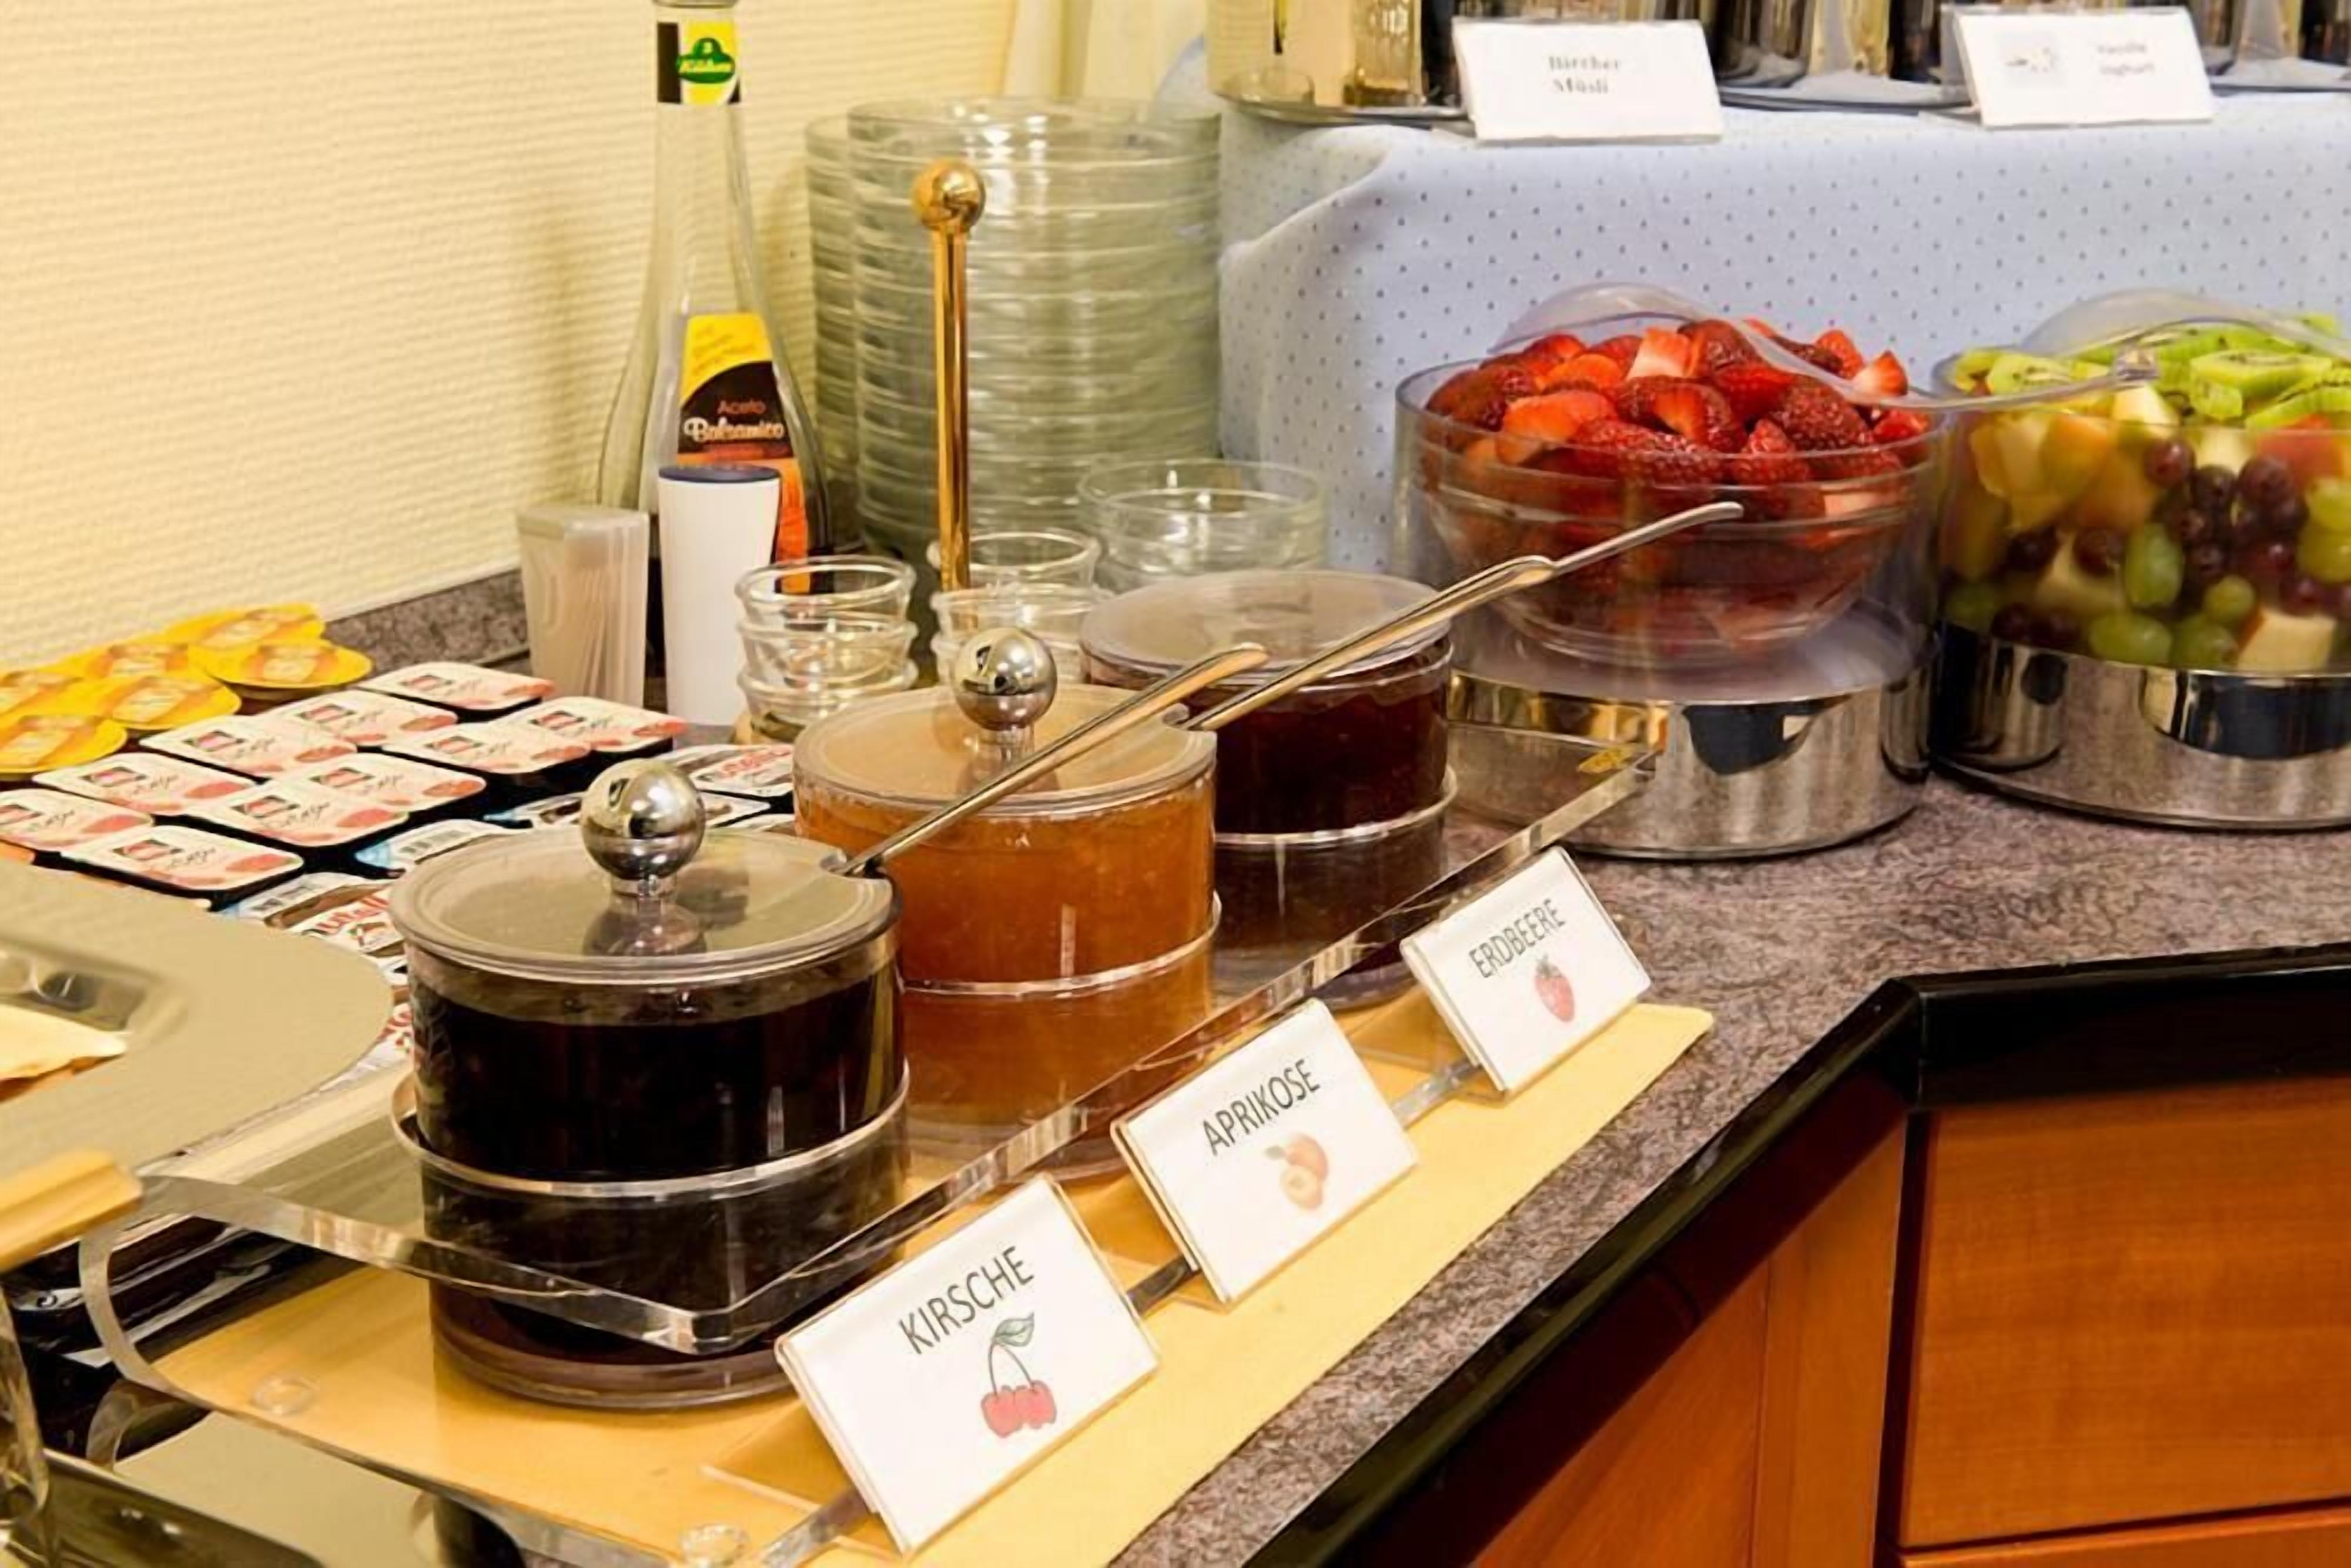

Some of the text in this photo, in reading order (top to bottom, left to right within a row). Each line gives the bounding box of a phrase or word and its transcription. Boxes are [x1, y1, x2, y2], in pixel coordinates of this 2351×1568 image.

[1469, 898, 1566, 979] ERDBEERE
[1201, 1058, 1321, 1156] APRIKOSE
[899, 1246, 1034, 1355] KIRSCHE
